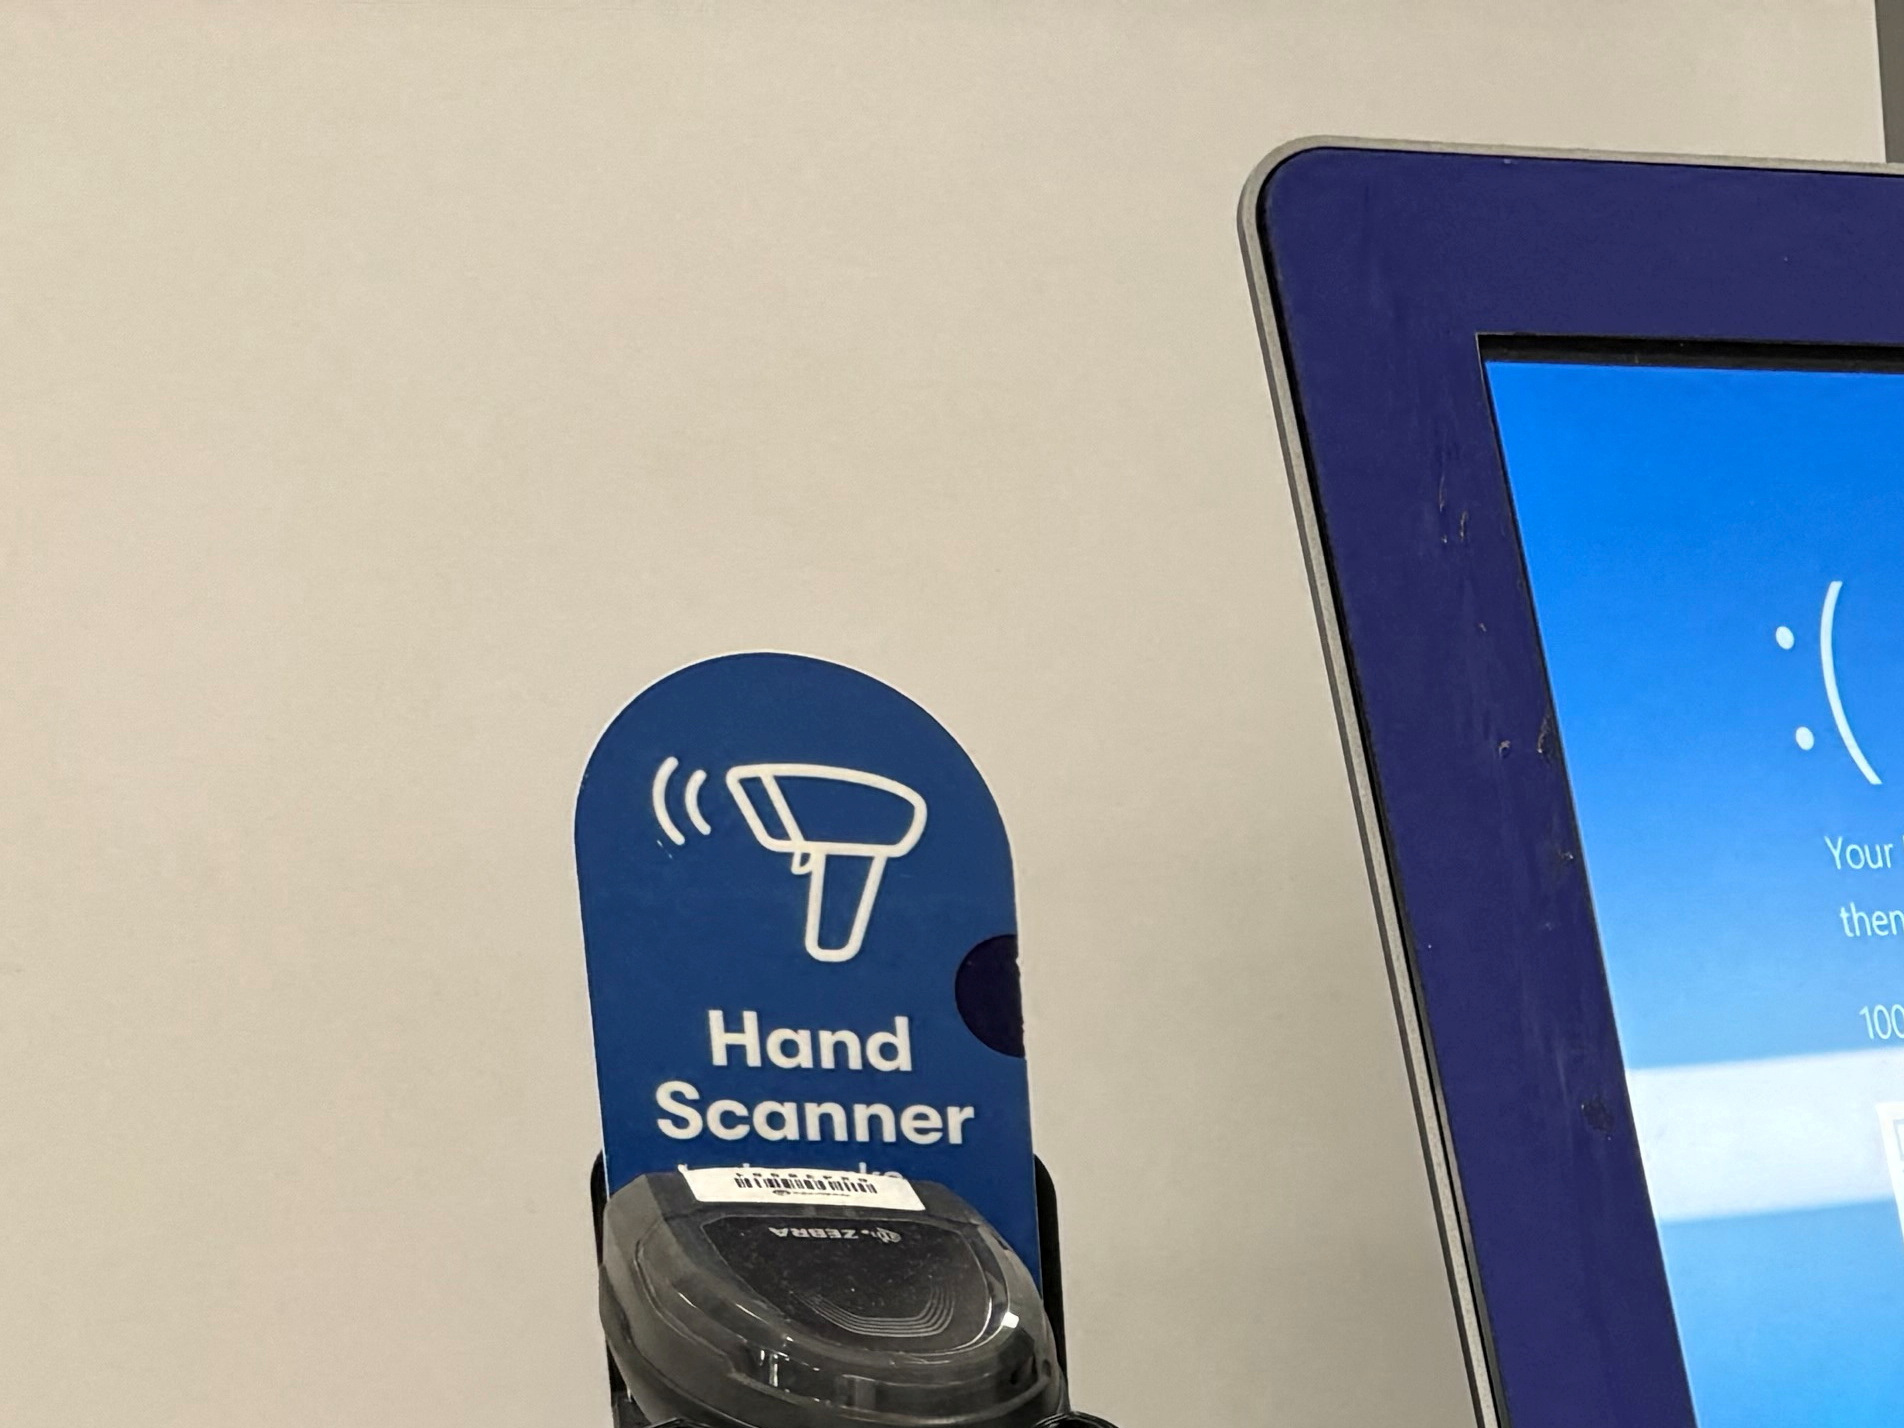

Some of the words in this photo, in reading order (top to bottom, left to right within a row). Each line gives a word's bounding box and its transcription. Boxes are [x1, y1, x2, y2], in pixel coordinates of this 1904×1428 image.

[1824, 834, 1894, 871] Your
[708, 1009, 913, 1072] Hand
[655, 1080, 975, 1145] Scanner
[768, 1226, 860, 1240] ZEBRA
